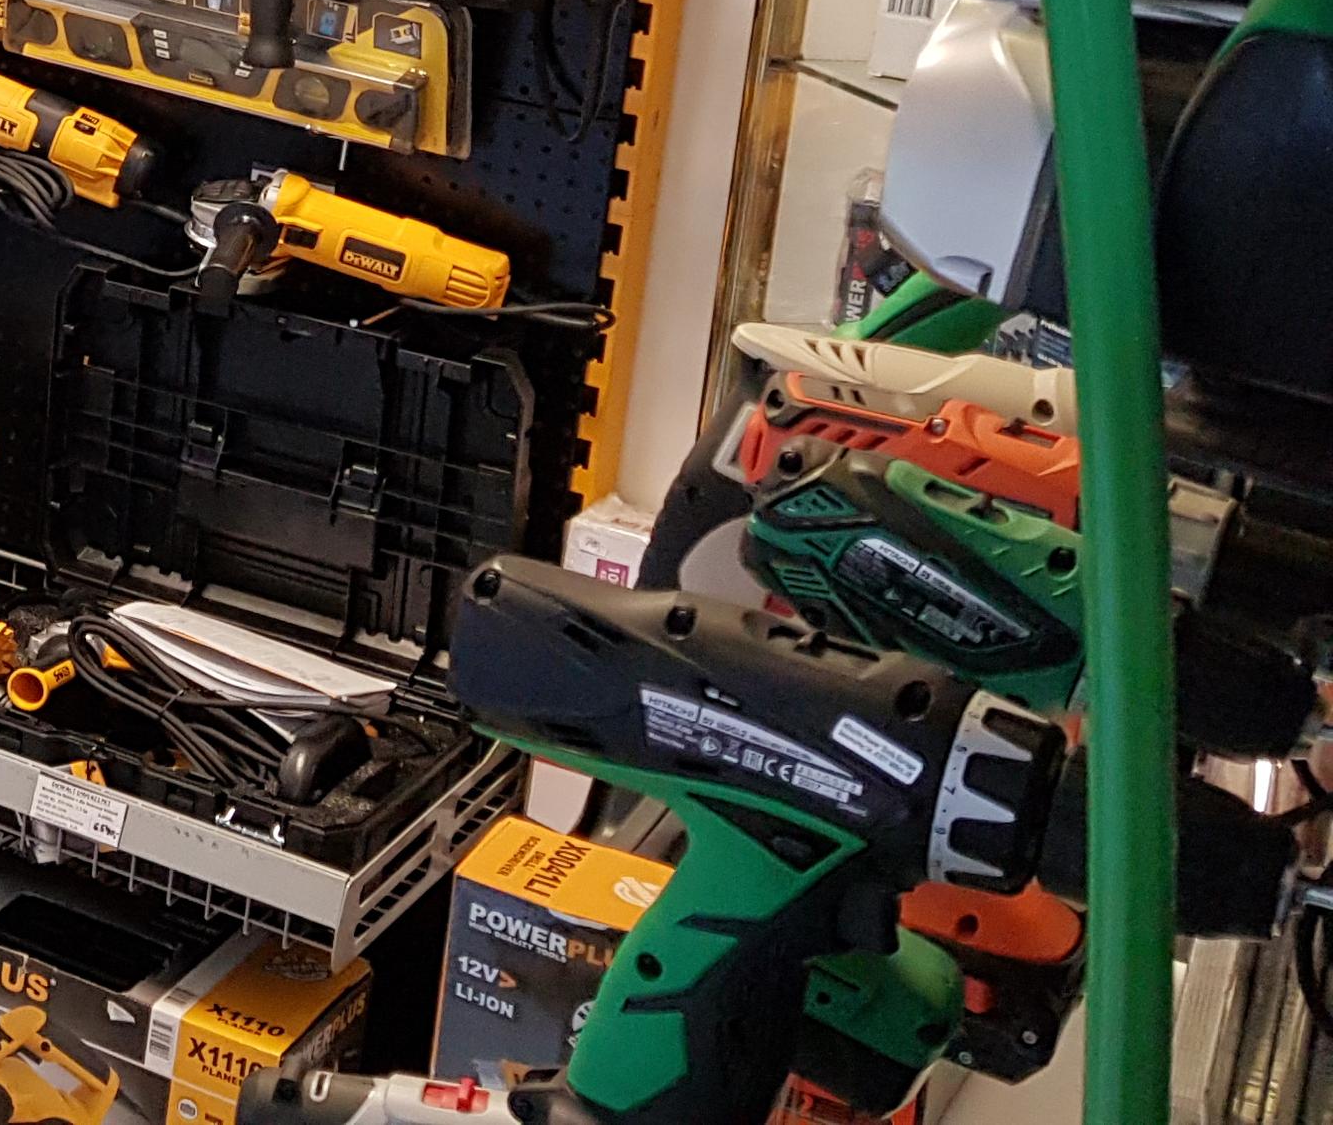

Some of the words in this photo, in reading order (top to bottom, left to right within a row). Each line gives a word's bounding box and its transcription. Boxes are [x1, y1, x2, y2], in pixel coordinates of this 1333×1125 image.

[343, 251, 400, 280] DEWALT
[524, 840, 592, 898] X0041LI
[458, 955, 499, 983] 12V
[536, 946, 567, 963] TOOLS
[455, 982, 514, 1019] LI-ION
[207, 1004, 285, 1036] X1110
[202, 1065, 242, 1086] PLANE
